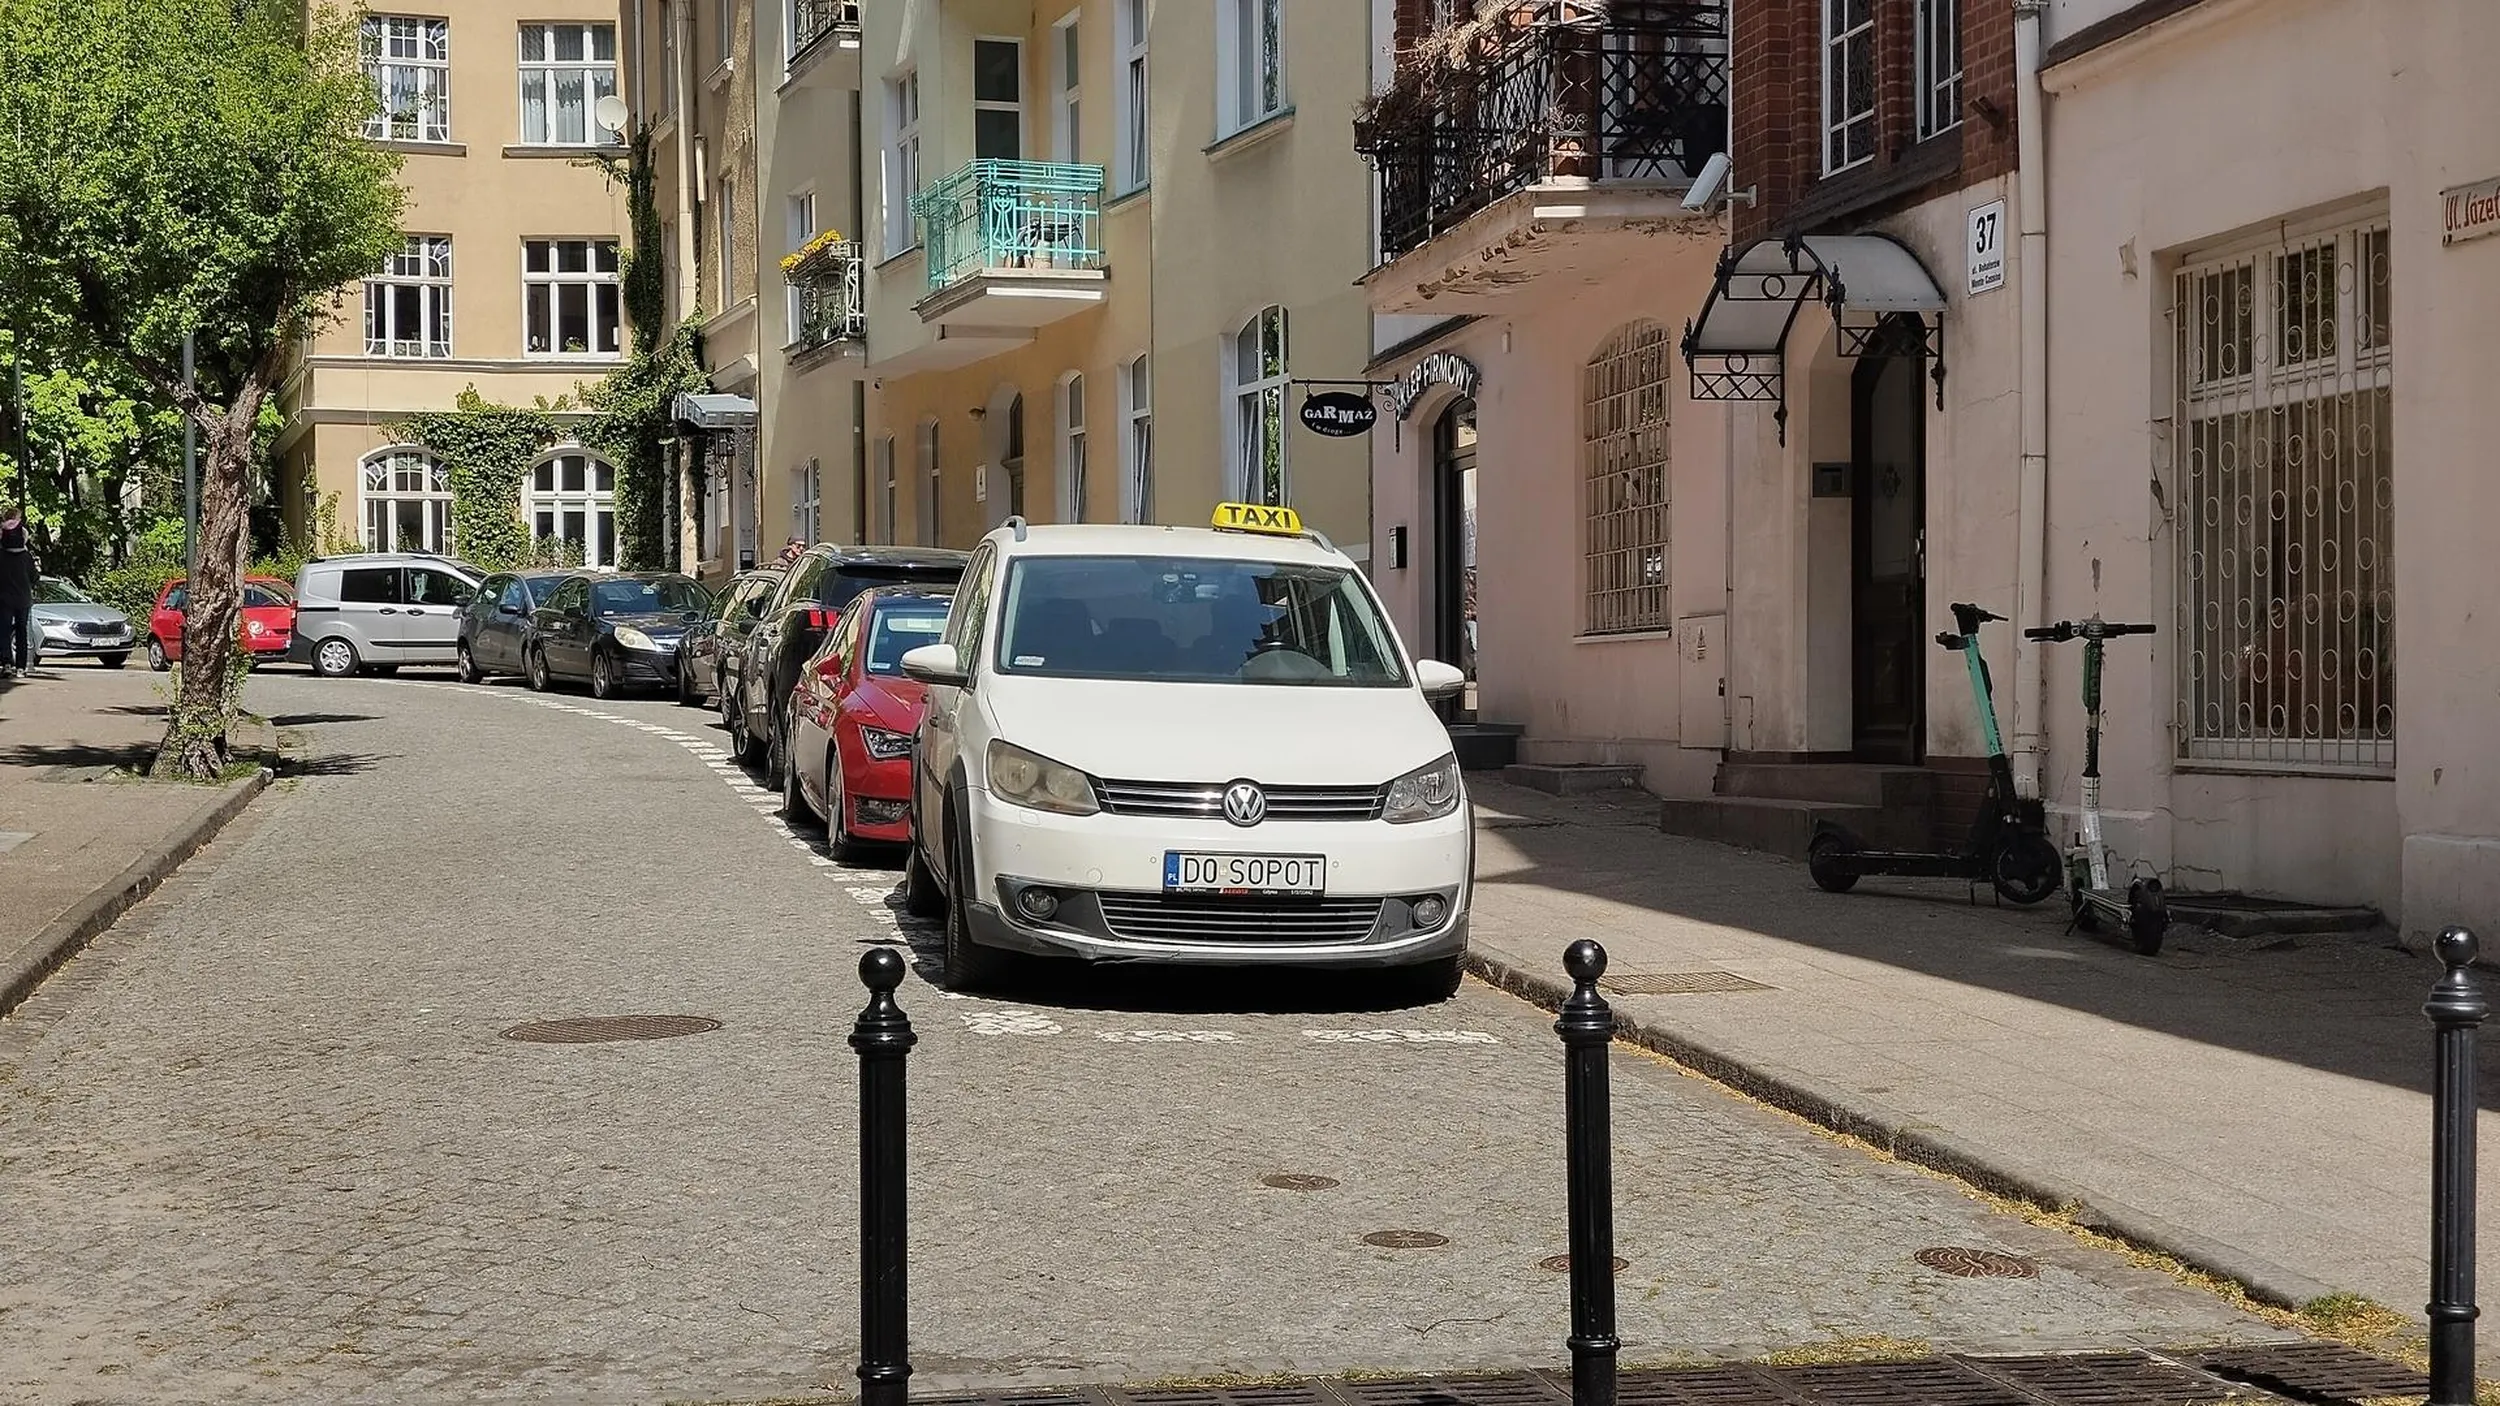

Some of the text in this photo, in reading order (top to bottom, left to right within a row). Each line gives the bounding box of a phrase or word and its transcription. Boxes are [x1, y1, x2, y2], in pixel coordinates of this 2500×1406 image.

[1976, 212, 1997, 254] 37
[1423, 353, 1474, 398] FIRMOWY
[1224, 505, 1291, 529] TAXI
[1167, 873, 1178, 881] PL
[1229, 858, 1320, 887] SOPOT
